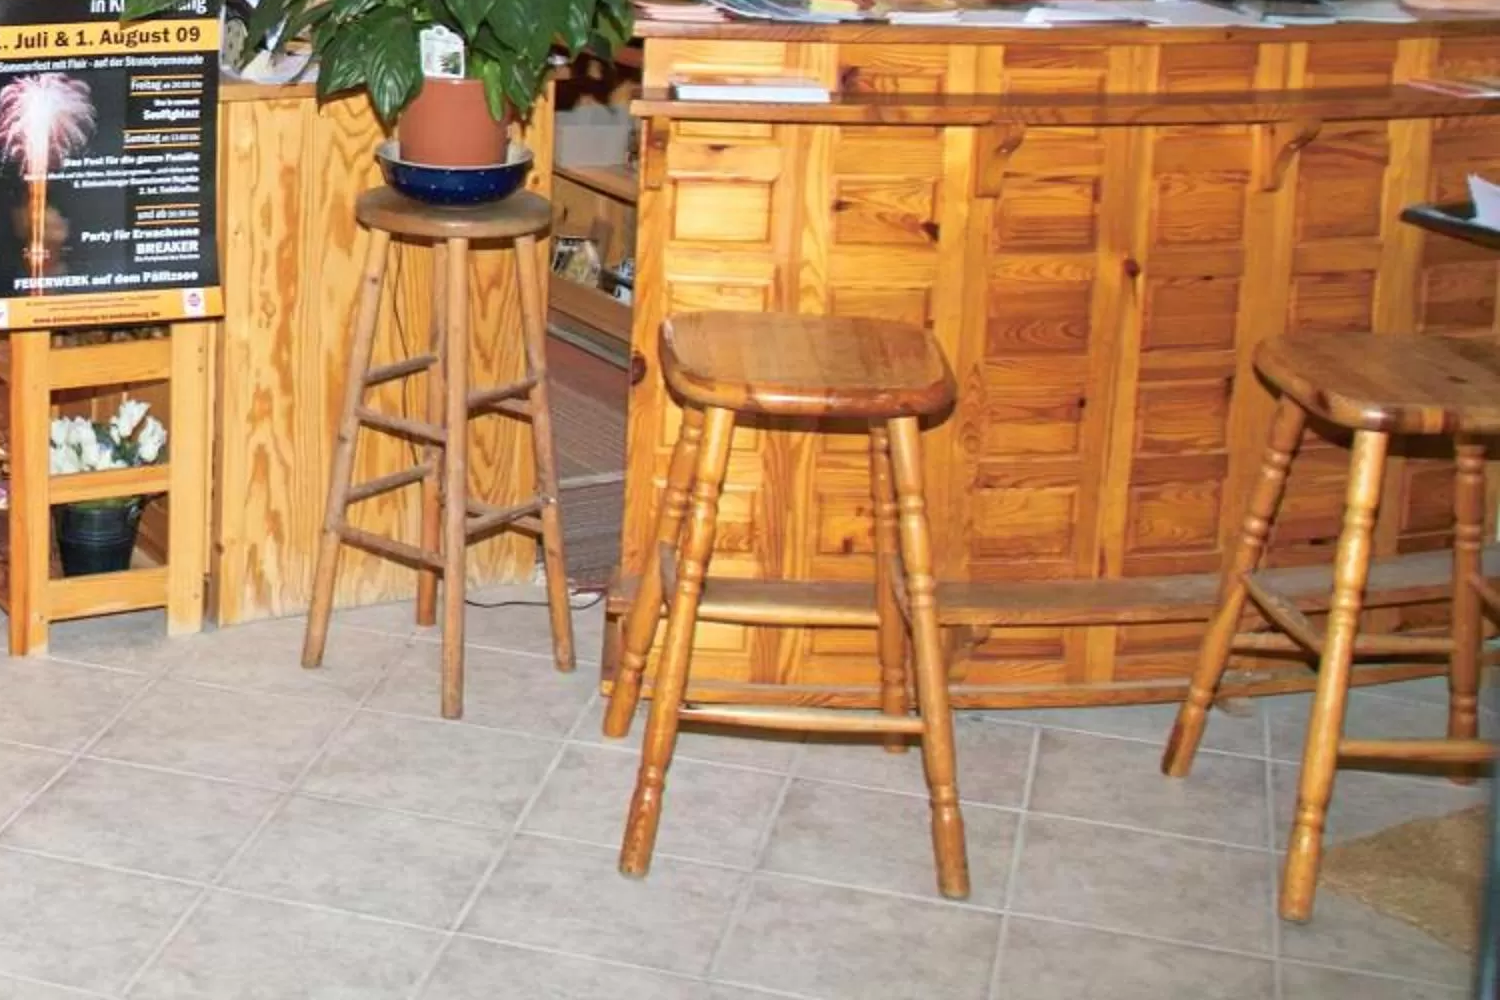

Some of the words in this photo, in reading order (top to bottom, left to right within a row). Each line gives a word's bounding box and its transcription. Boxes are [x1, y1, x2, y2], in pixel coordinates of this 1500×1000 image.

[14, 31, 48, 49] Juli
[54, 31, 69, 47] &
[74, 29, 93, 46] 1.
[99, 27, 170, 48] August
[175, 26, 201, 43] 09
[81, 231, 112, 244] Party
[113, 229, 131, 241] für
[131, 227, 200, 239] Erwachsene
[135, 240, 199, 255] BREAKER
[14, 274, 89, 291] FEUERWERK
[90, 273, 113, 286] auf
[113, 273, 141, 285] dem
[142, 270, 199, 284] Pälitzsee
